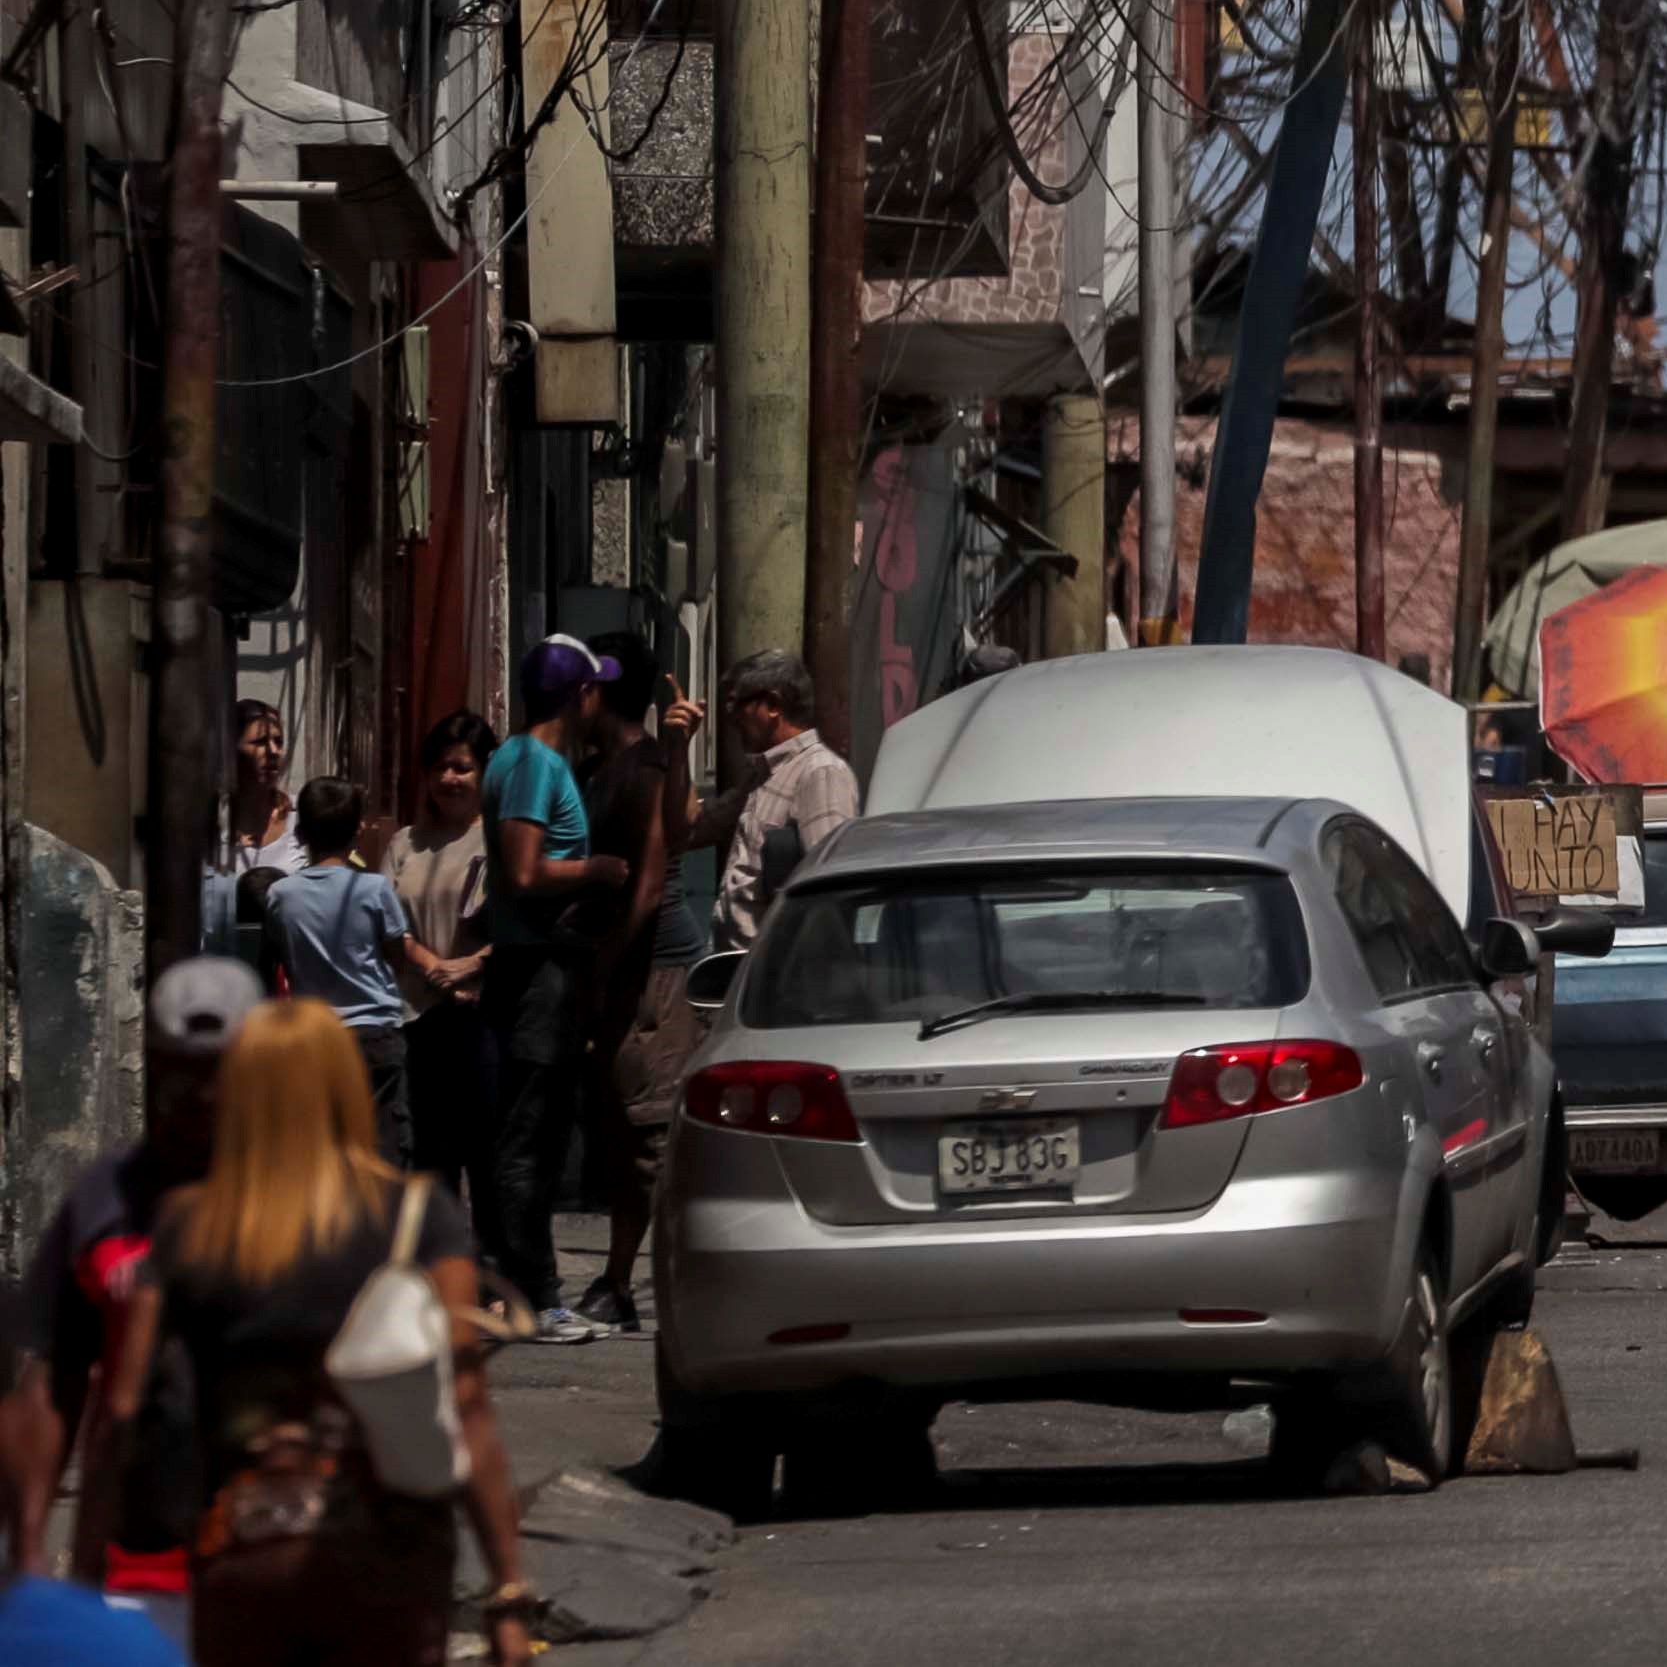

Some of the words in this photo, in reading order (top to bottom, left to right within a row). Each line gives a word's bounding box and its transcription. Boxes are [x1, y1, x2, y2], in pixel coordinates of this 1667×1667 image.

[1534, 798, 1601, 847] HAY
[1508, 845, 1605, 891] UNTO
[1015, 1135, 1069, 1172] 83G
